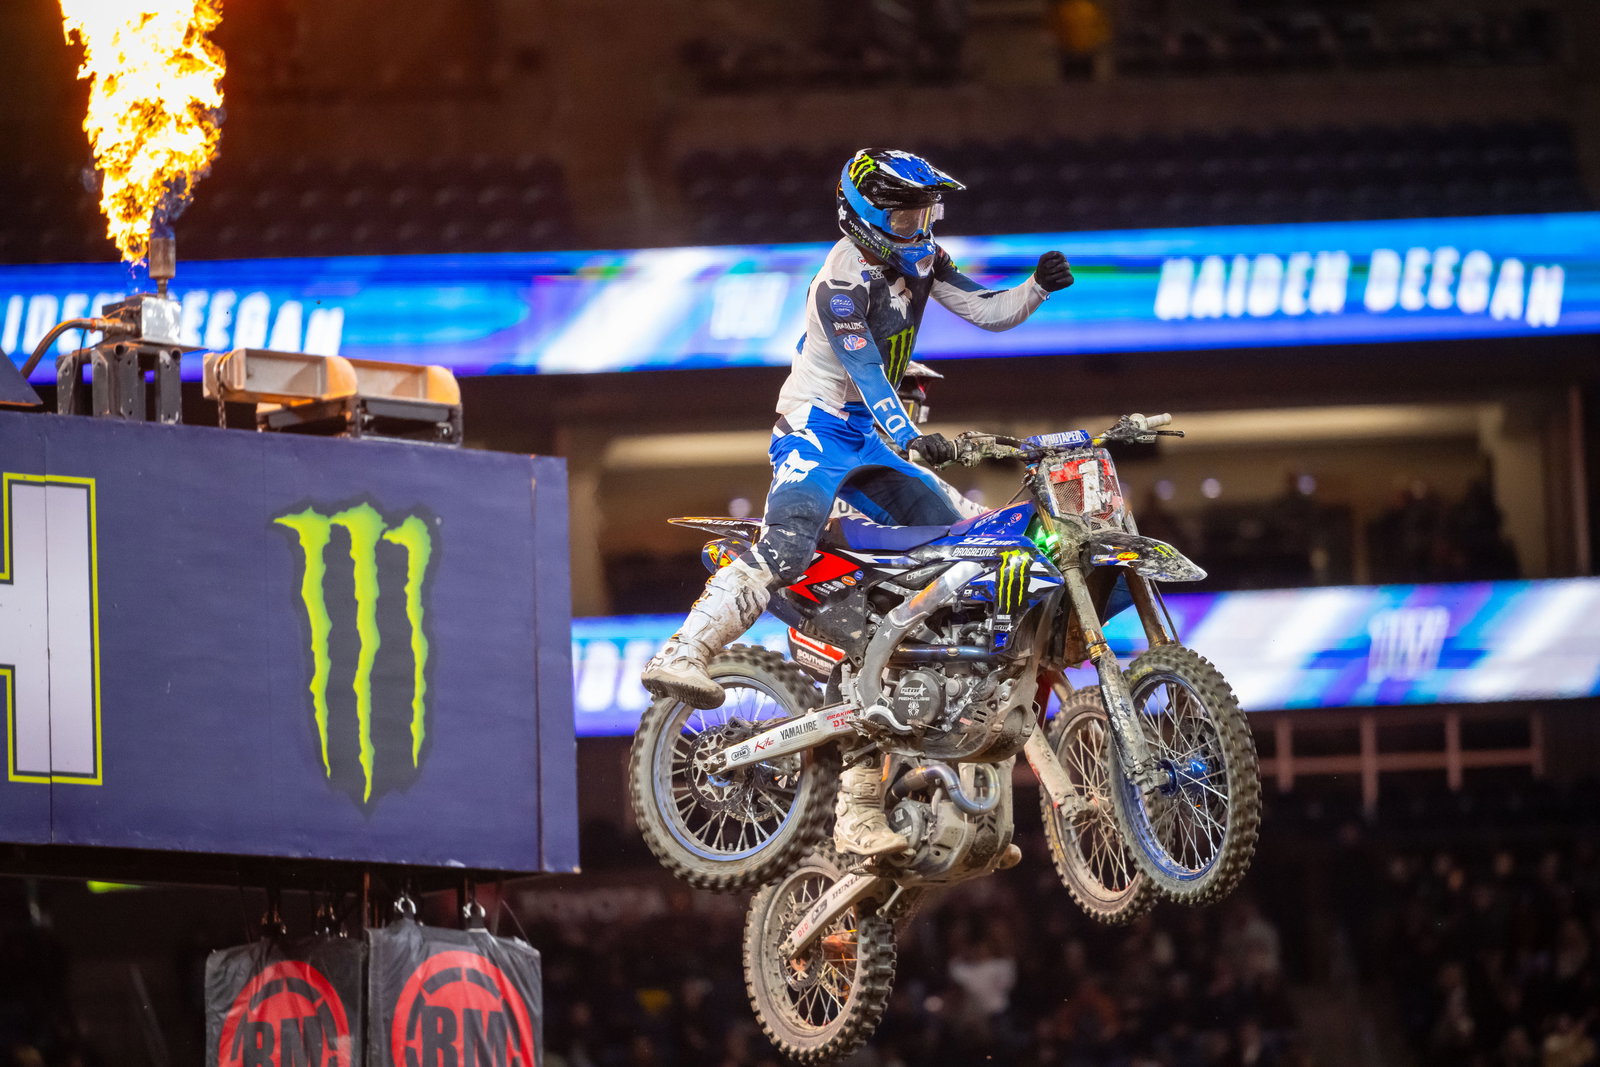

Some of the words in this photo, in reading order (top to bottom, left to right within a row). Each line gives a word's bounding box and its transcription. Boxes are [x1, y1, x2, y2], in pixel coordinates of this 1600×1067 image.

[1364, 246, 1565, 328] DEEGAN
[872, 397, 907, 434] FO
[951, 547, 997, 558] PROGRESSIVE
[826, 709, 855, 721] BRAKIN
[832, 718, 845, 728] DI
[780, 719, 818, 741] YAMALUBE
[832, 875, 861, 899] DUNLO
